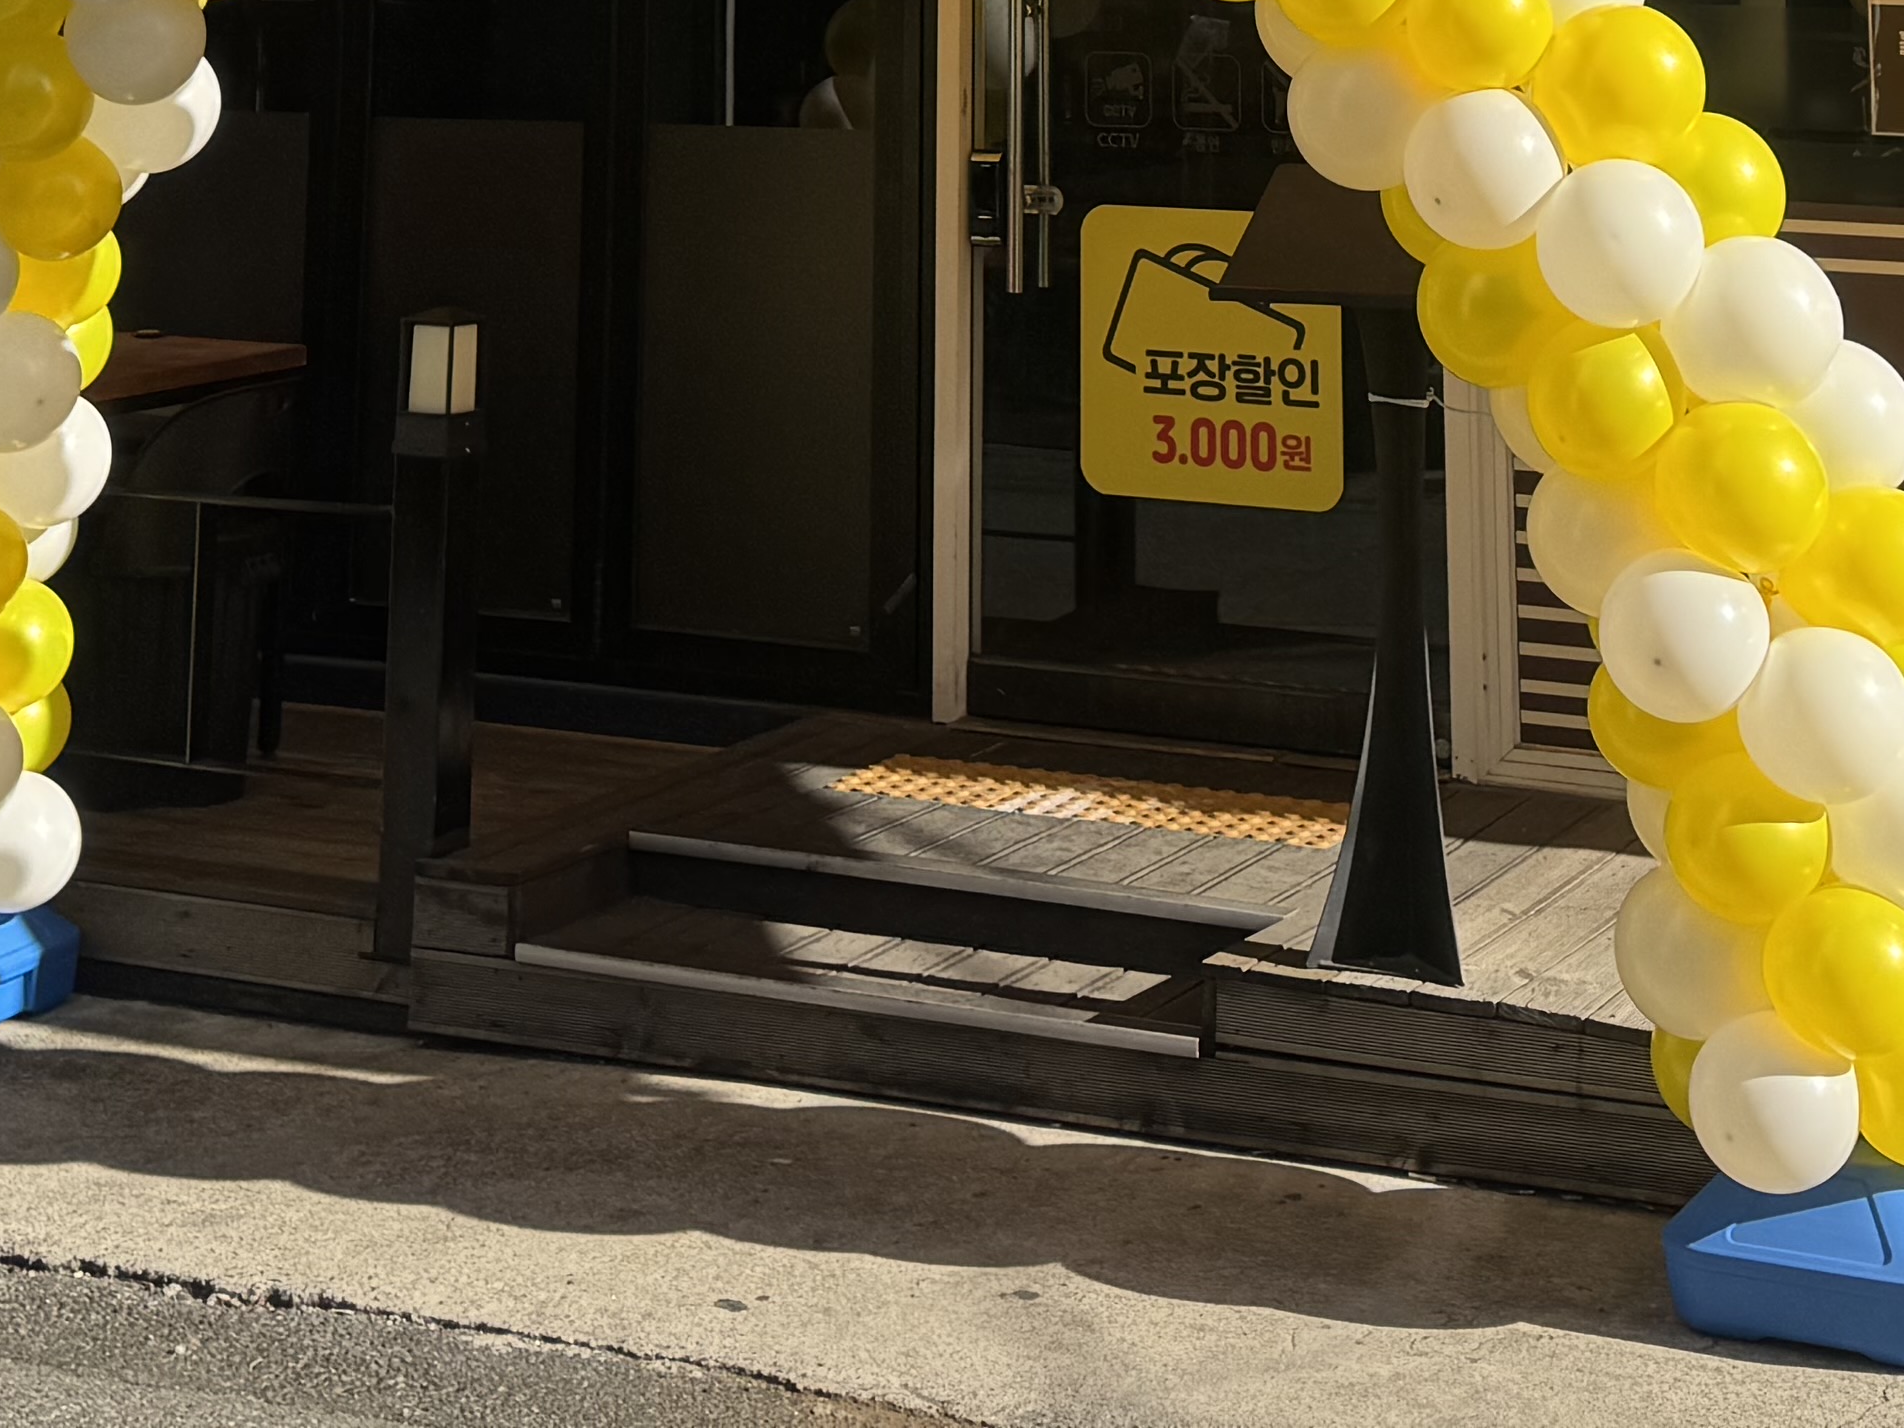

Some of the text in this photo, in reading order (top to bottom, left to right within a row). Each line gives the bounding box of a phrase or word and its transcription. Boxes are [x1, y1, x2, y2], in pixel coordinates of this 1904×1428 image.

[1096, 132, 1140, 149] CCTV
[1143, 348, 1321, 409] 포장할인
[1152, 414, 1313, 473] 3.000원
